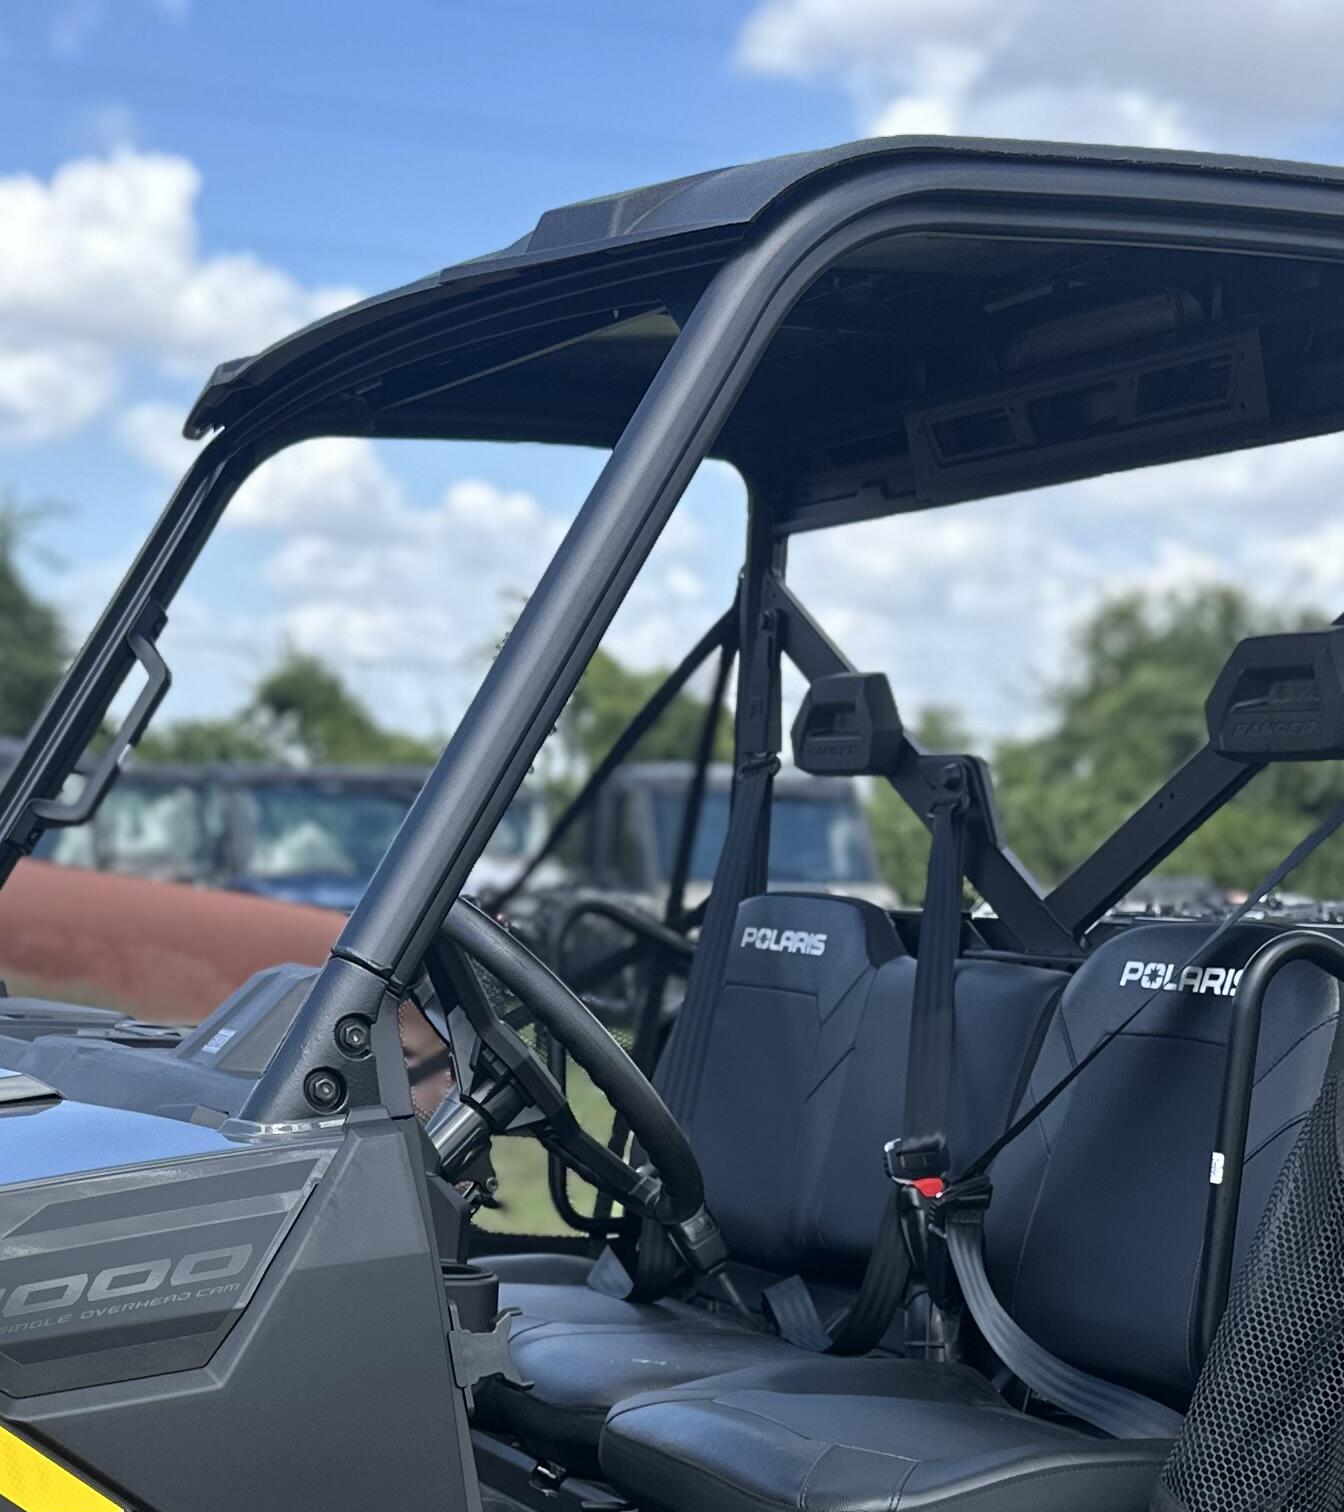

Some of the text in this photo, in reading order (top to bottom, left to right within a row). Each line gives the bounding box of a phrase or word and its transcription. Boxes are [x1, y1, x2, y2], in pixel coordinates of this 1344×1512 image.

[739, 926, 827, 957] POLARIS
[80, 1290, 191, 1320] OVERHEAD
[193, 1281, 241, 1299] CAM
